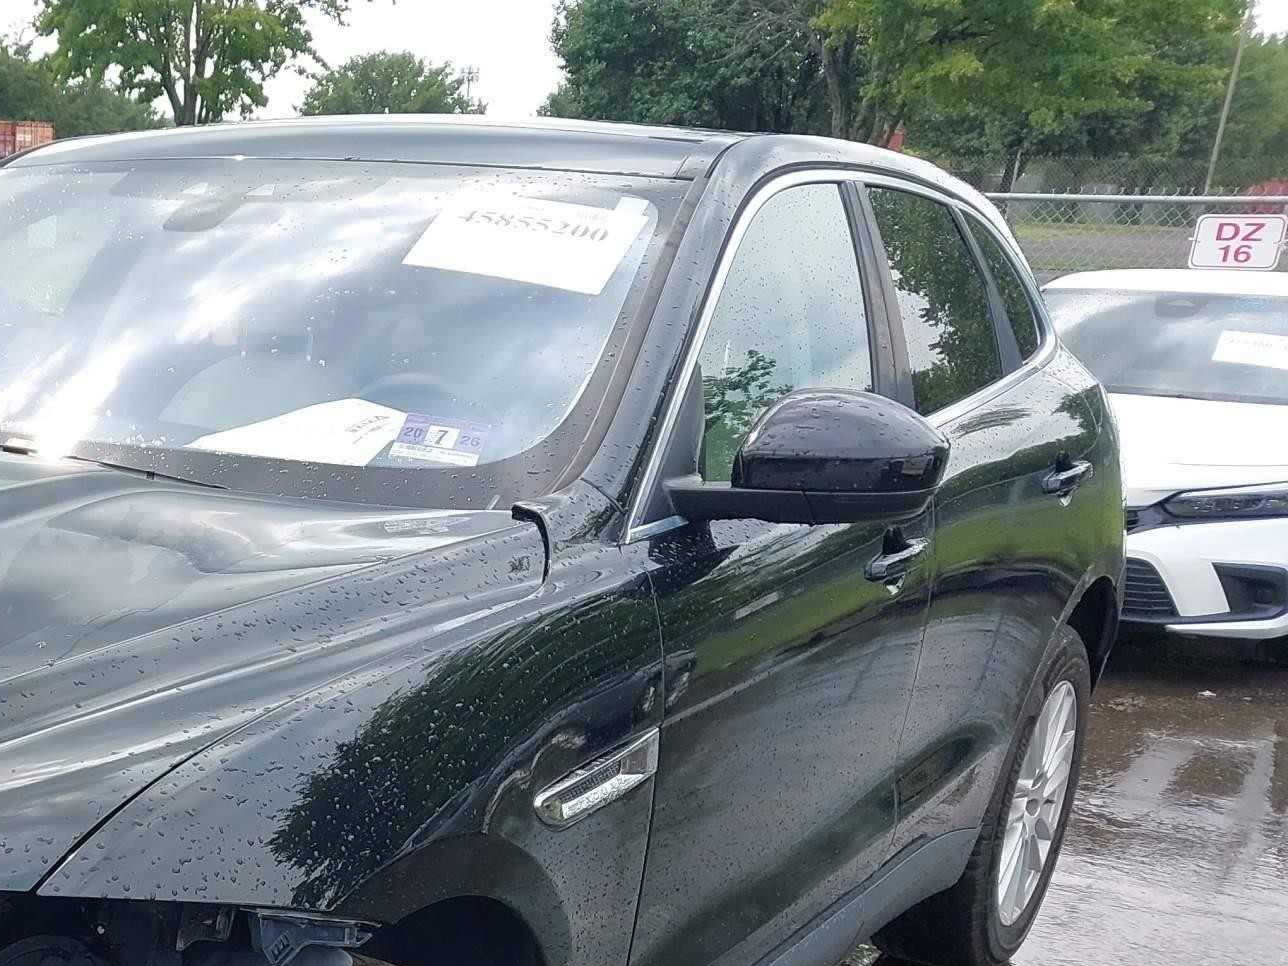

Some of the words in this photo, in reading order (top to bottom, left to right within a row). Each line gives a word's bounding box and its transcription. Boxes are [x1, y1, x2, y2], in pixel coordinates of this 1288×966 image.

[457, 210, 610, 242] 45855200
[1215, 222, 1267, 242] DZ
[1218, 245, 1253, 263] 16
[403, 426, 425, 439] 20
[434, 429, 449, 445] 7
[459, 435, 482, 447] 26
